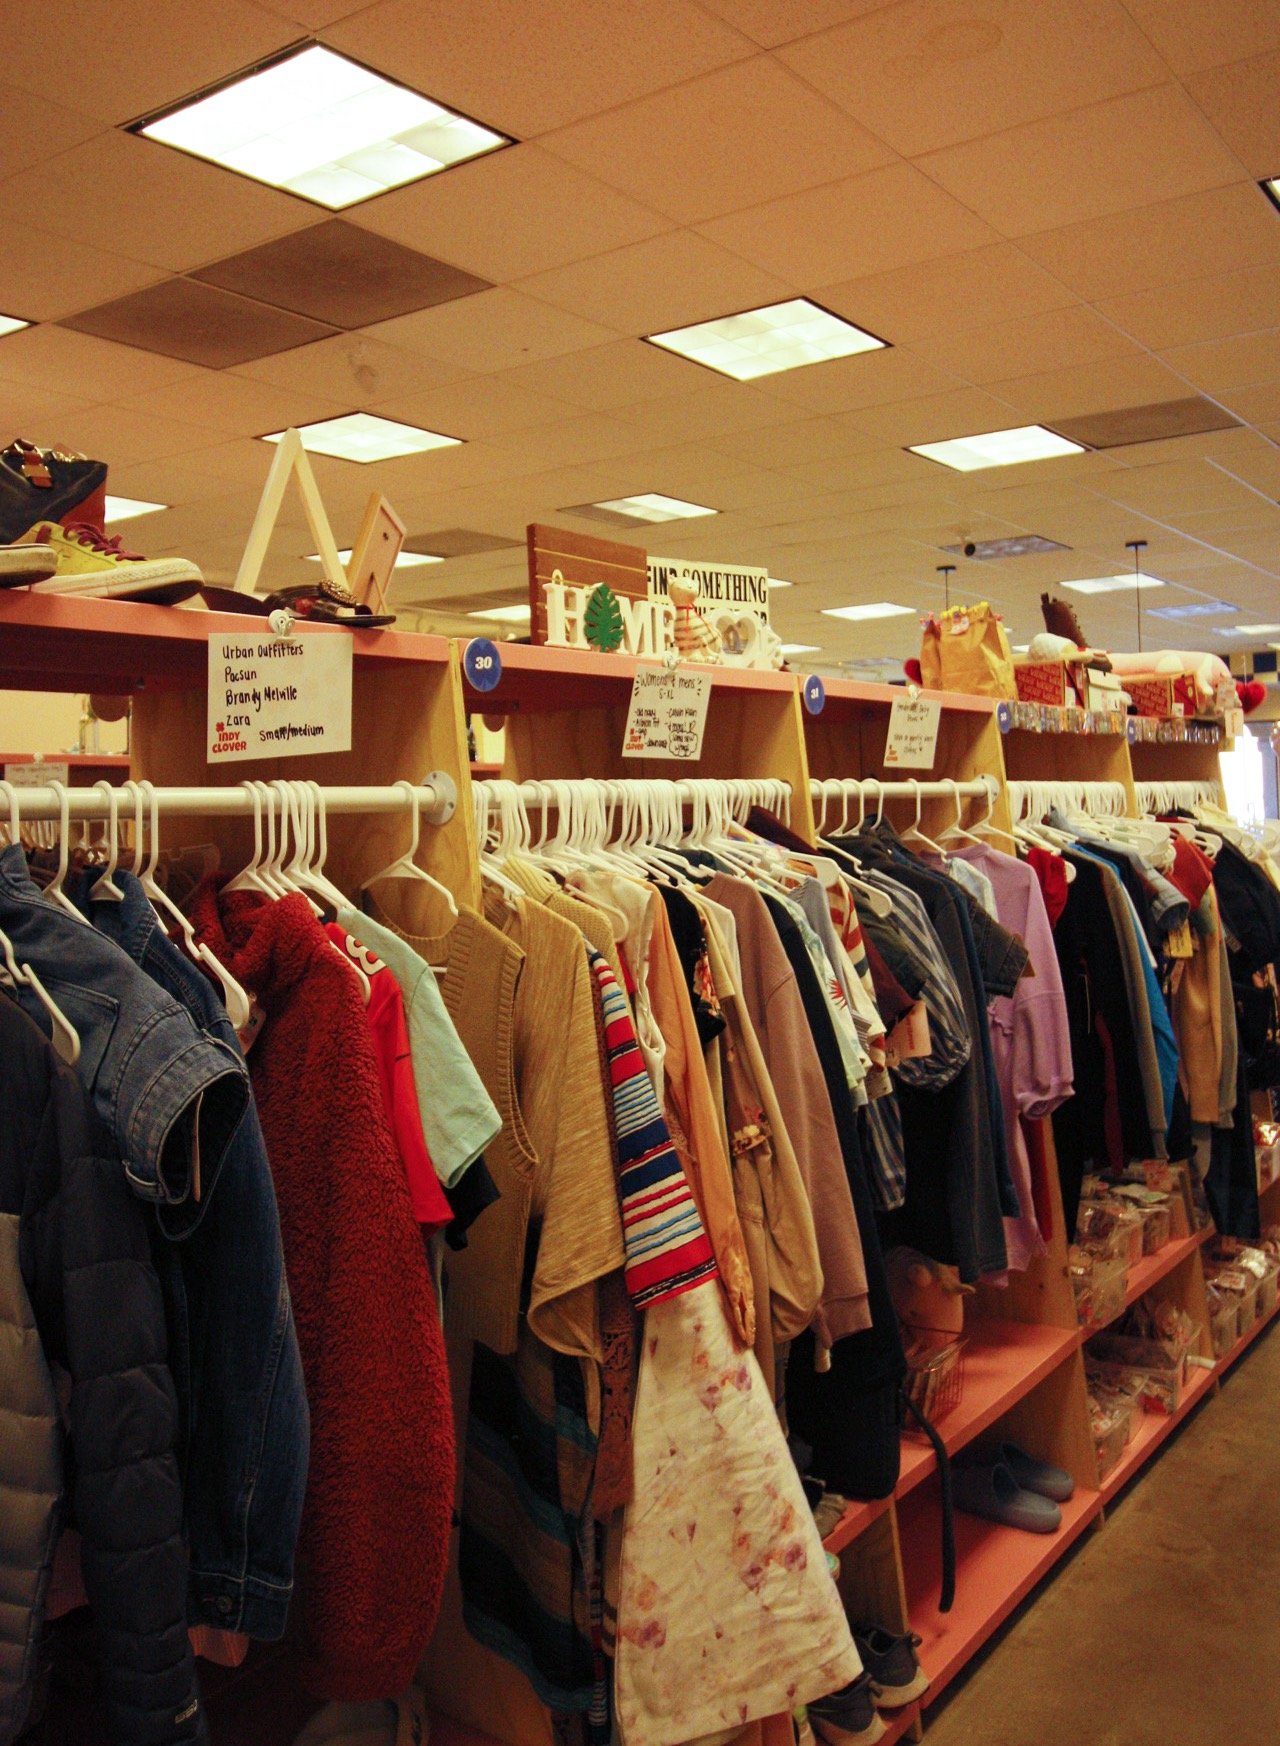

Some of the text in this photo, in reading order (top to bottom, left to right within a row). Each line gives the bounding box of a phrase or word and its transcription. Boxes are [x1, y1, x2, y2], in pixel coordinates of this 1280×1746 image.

[542, 582, 680, 660] HME
[222, 644, 303, 660] Urban Outfitters
[475, 656, 492, 670] 30
[226, 685, 297, 712] Brandy Melville
[810, 687, 819, 699] 31
